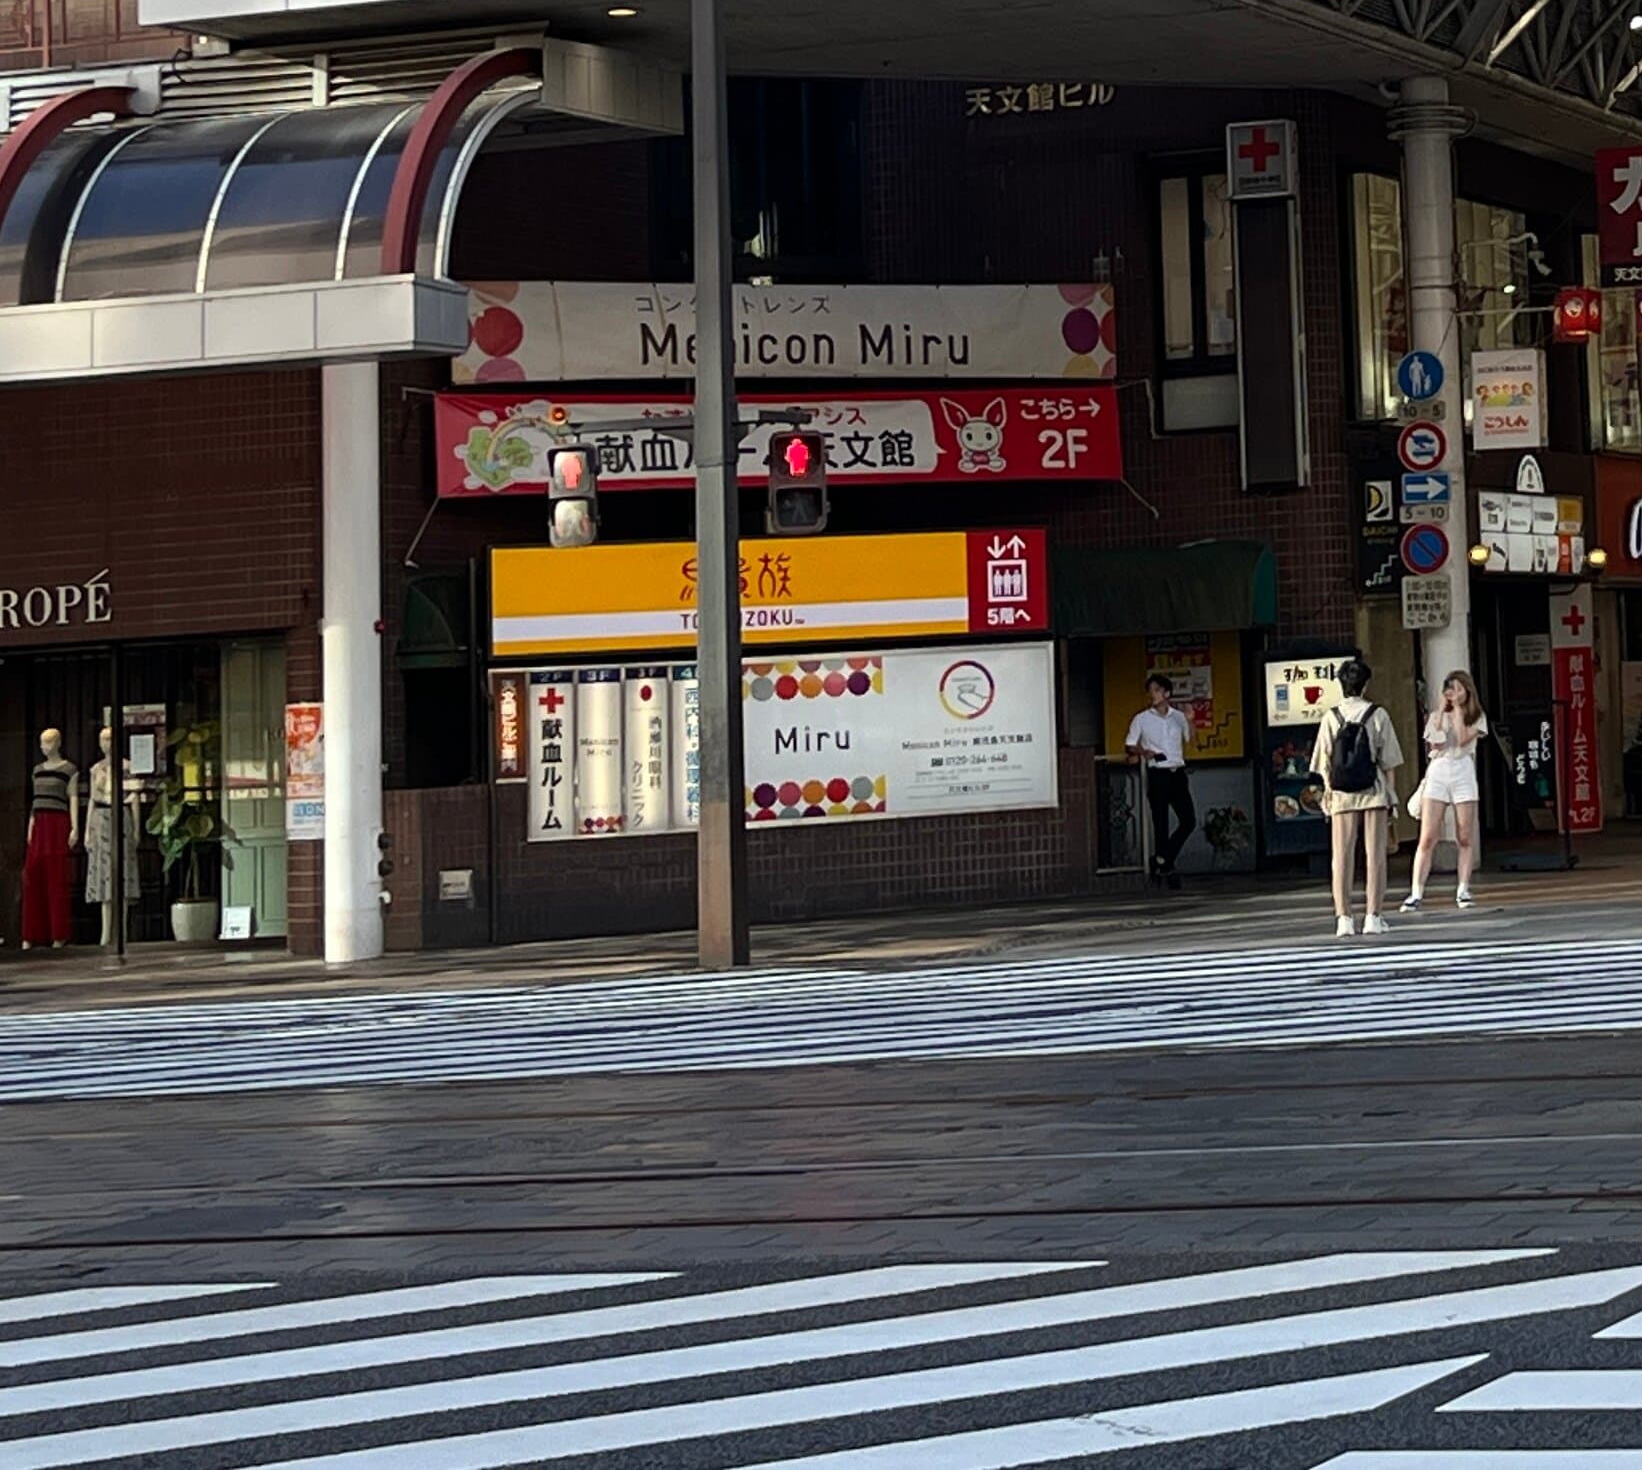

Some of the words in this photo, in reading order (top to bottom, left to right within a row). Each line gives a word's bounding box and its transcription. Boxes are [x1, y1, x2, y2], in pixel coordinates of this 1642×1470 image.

[965, 82, 1115, 116] 天文館ビル
[635, 295, 831, 314] コントレンズ
[640, 323, 835, 365] Meicon
[858, 323, 970, 365] Miru
[1019, 397, 1076, 420] こちら
[1038, 428, 1089, 469] 2F
[0, 568, 113, 629] ROPÉ
[774, 724, 851, 755] Miru
[541, 717, 563, 830] 献血ルーム
